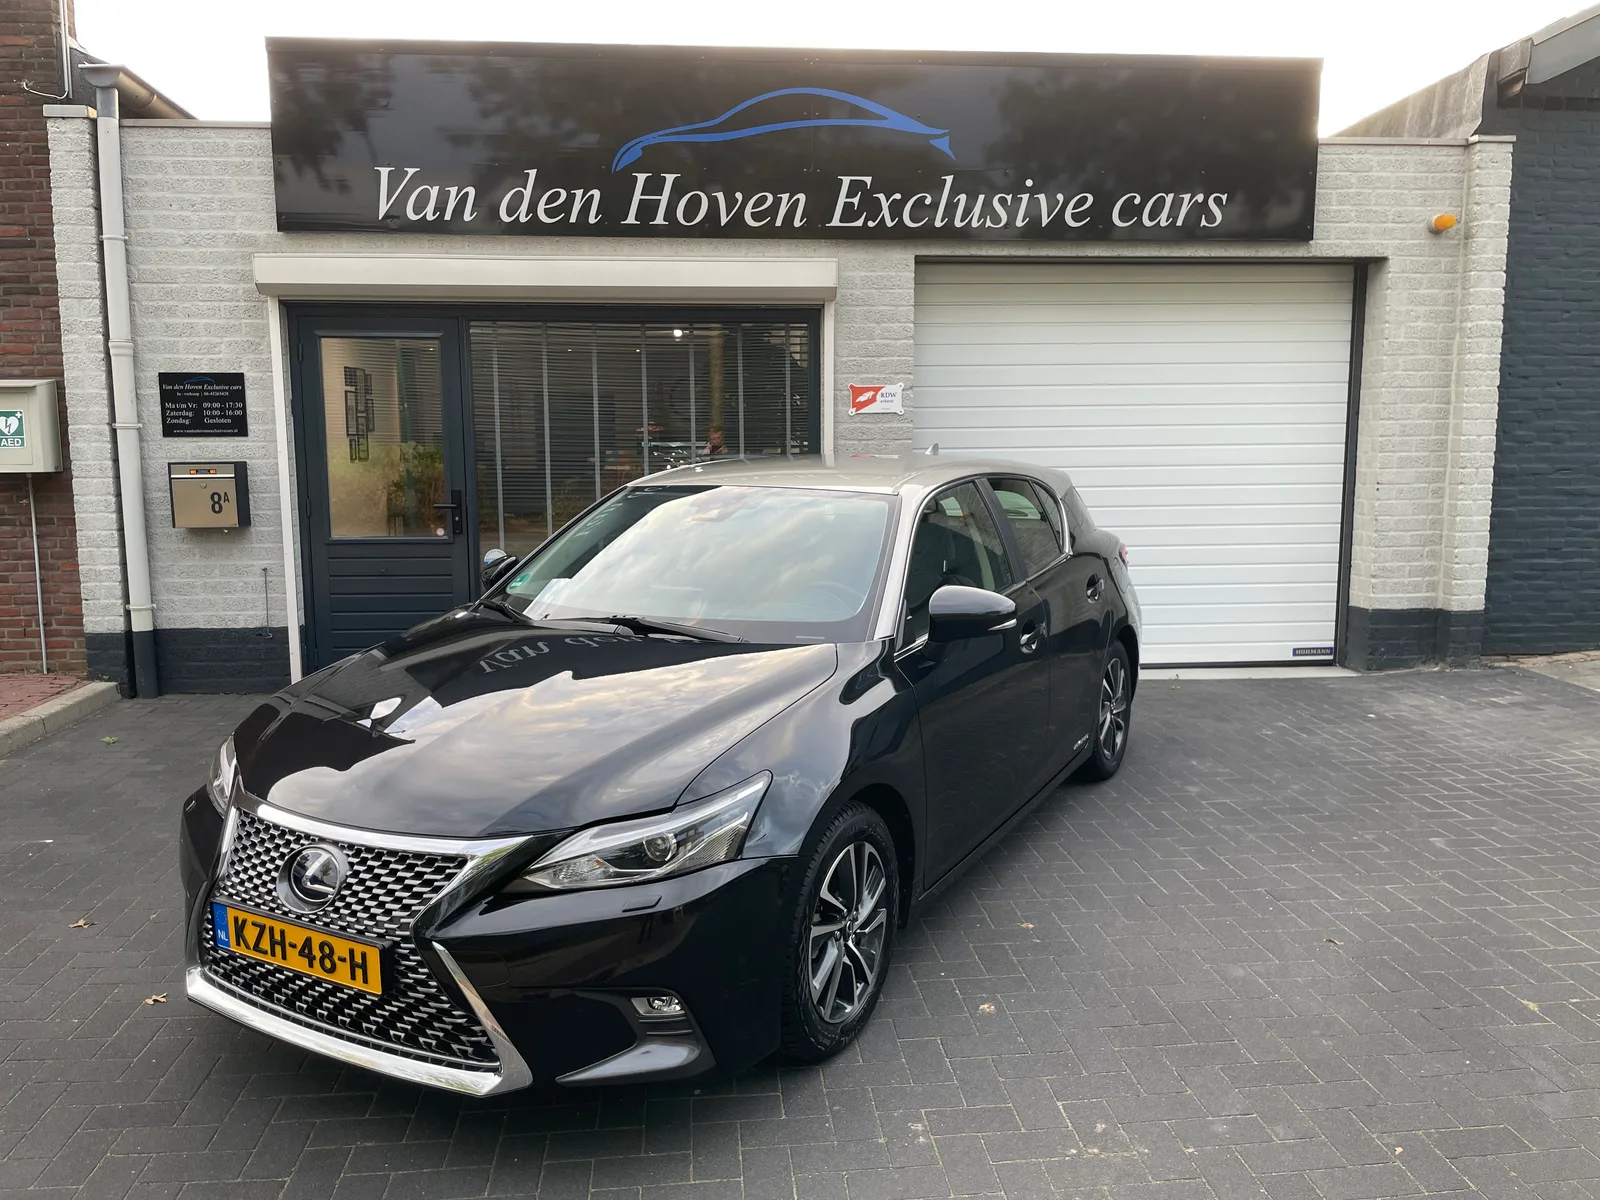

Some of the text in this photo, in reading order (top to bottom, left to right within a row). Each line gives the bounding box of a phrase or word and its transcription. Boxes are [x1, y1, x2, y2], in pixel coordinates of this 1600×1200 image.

[373, 166, 1228, 228] Van den Hoven Exclusive cars
[1, 438, 22, 446] AED
[218, 929, 228, 942] NL
[234, 915, 368, 984] KZH-48-H
